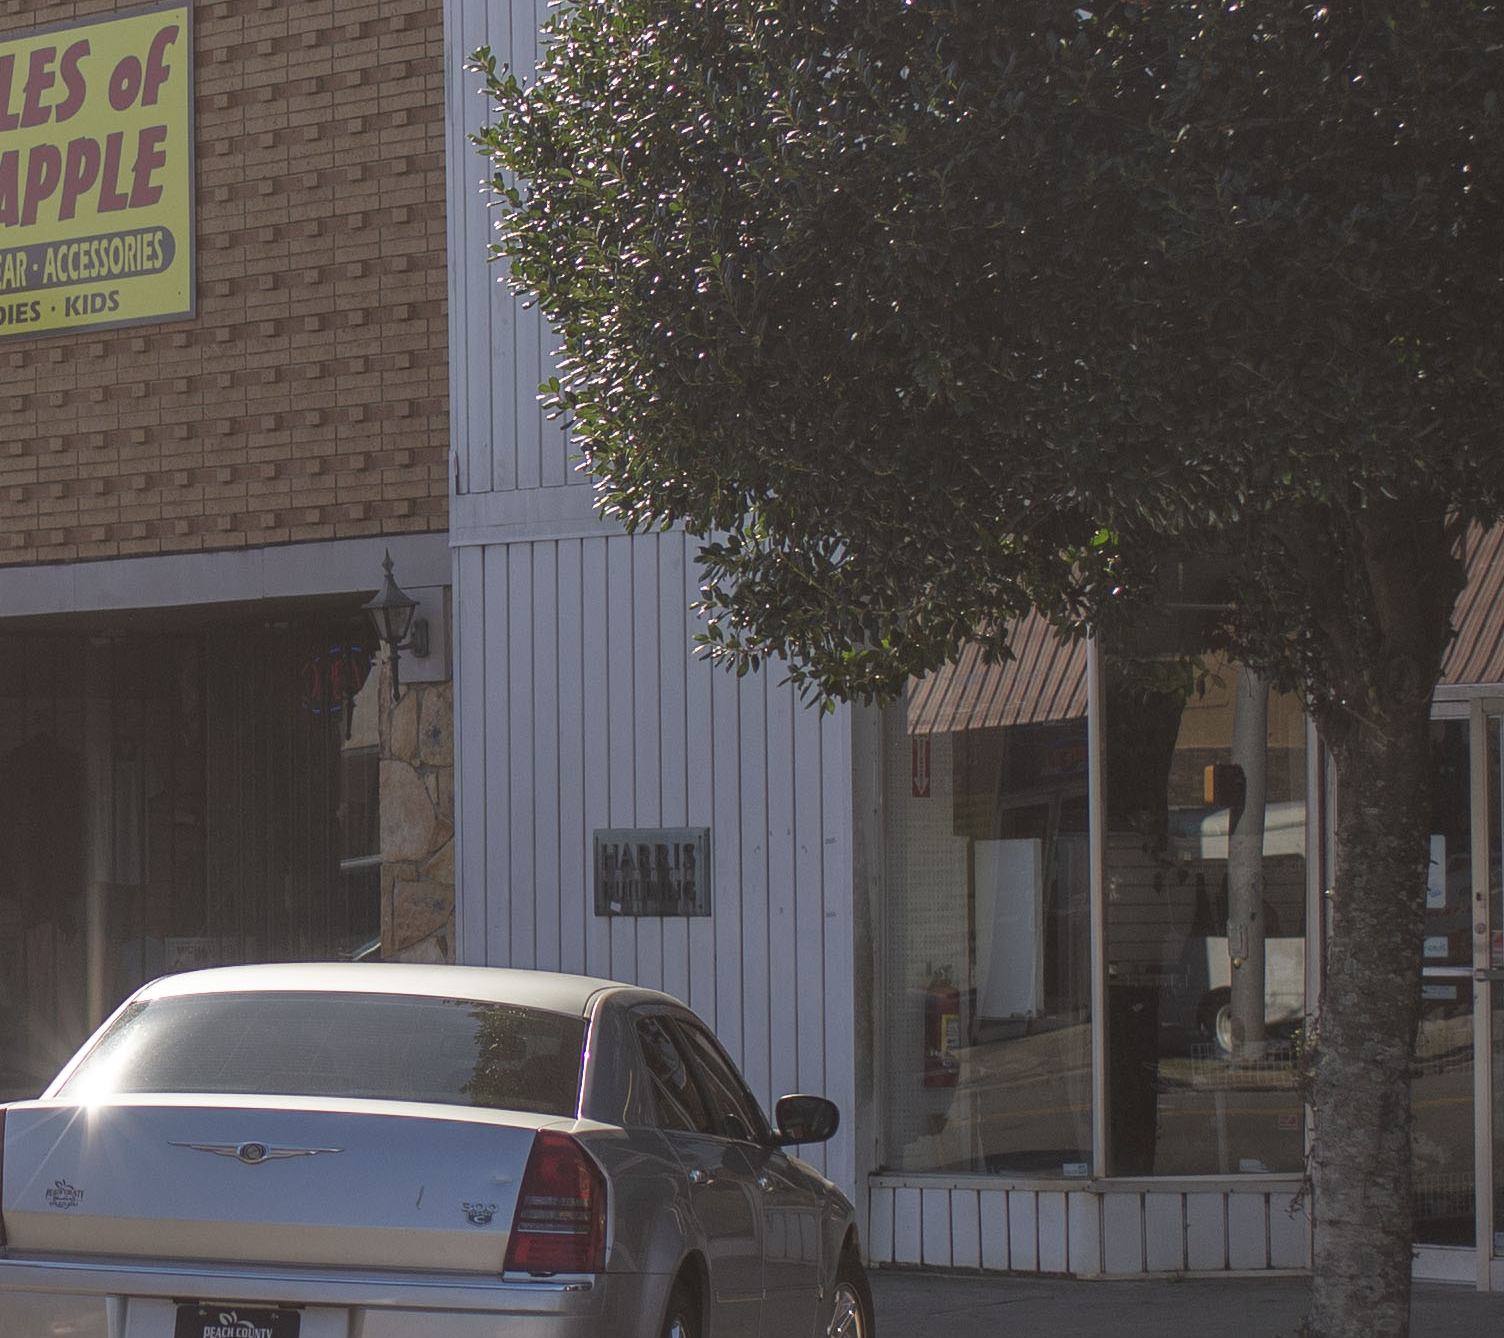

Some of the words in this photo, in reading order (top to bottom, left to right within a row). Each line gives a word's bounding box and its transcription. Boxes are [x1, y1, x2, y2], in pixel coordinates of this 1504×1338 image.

[108, 25, 180, 111] of
[42, 231, 163, 283] ACCESSORIES
[64, 289, 120, 318] KIDS
